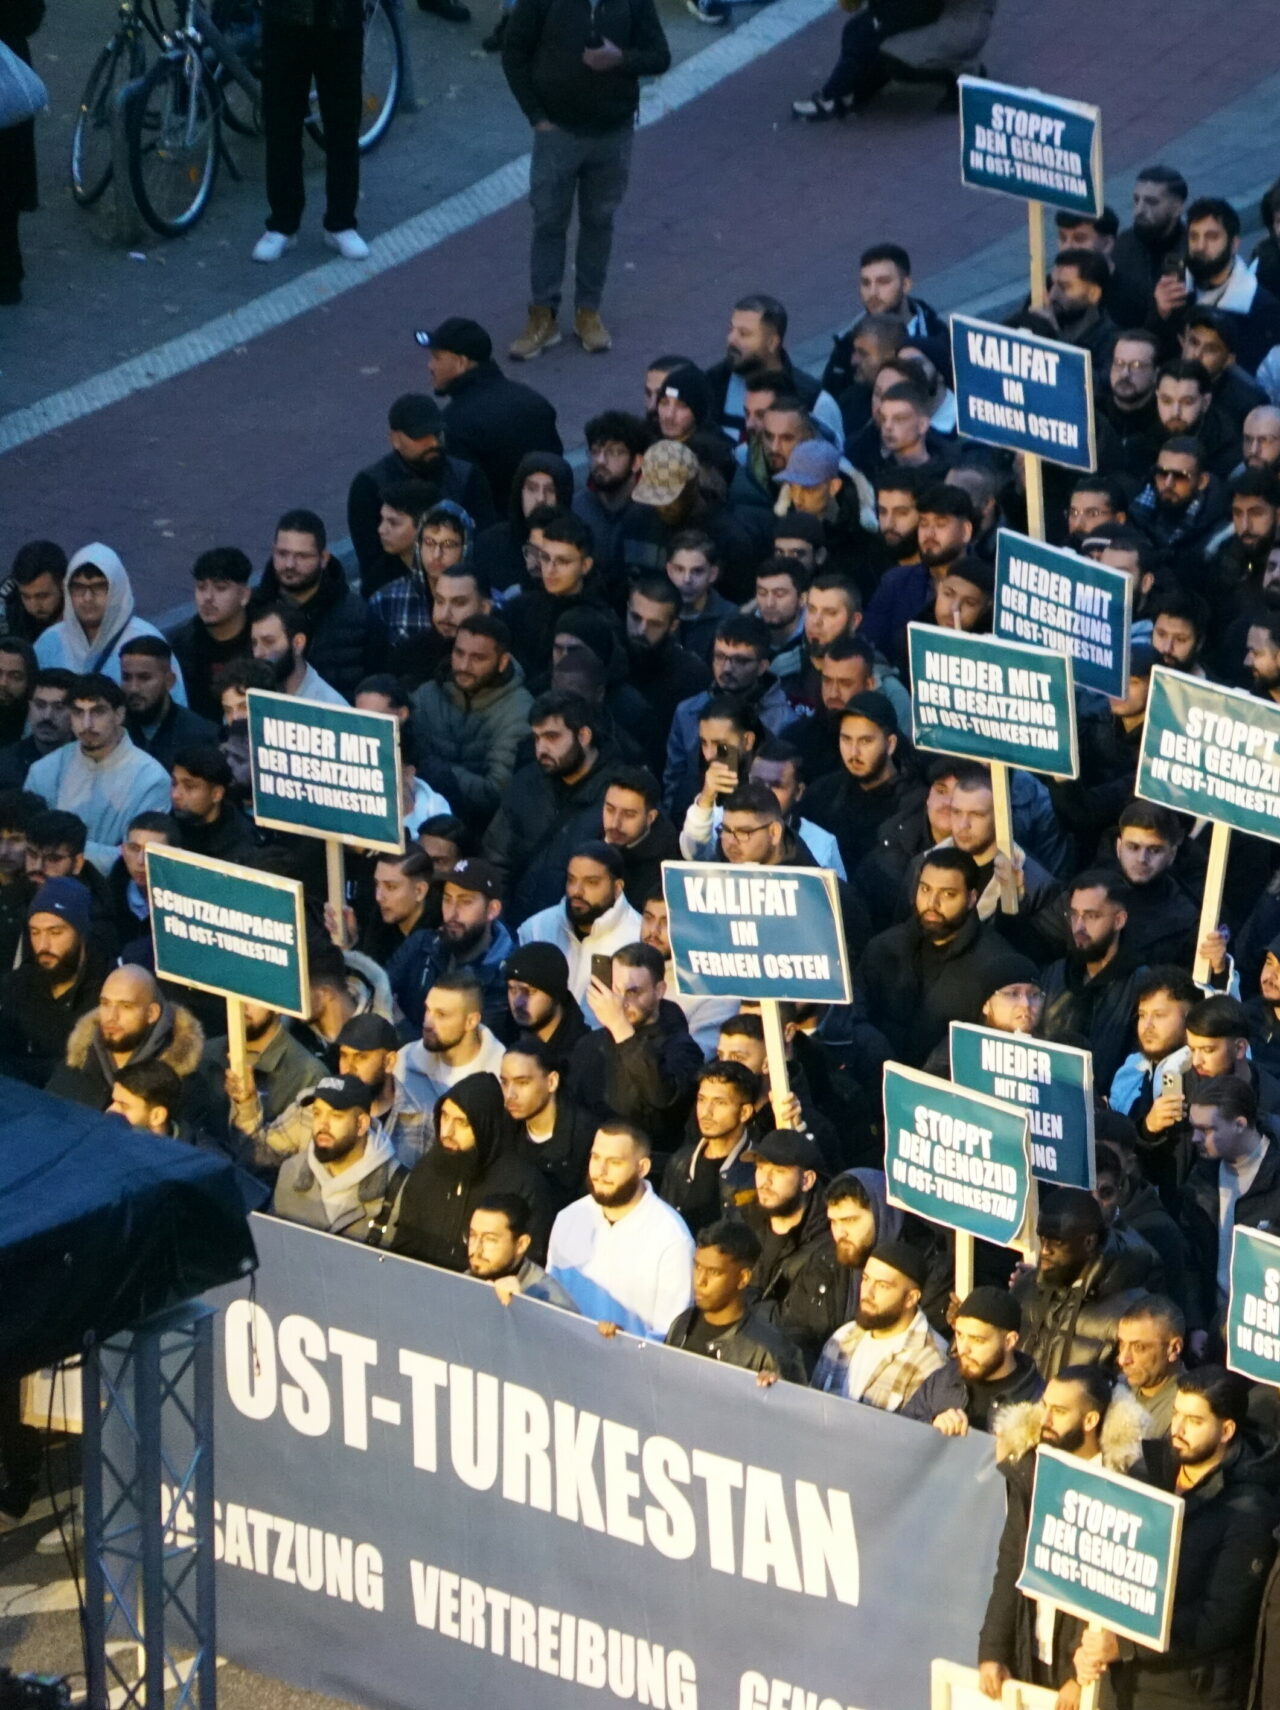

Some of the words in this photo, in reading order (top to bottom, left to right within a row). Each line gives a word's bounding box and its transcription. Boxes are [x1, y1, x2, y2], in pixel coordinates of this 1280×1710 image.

[992, 103, 1064, 146] STOPPT
[975, 126, 1006, 155] DEN
[1011, 136, 1080, 175] GENOZID
[968, 333, 1059, 385] KALIFAT
[1003, 379, 1024, 404] IM
[969, 397, 1025, 432] FERNEN
[1028, 413, 1078, 447] OSTEN
[1008, 557, 1071, 606] NIEDER
[1075, 581, 1111, 619] MIT
[1000, 610, 1013, 633] IN
[1001, 584, 1027, 617] DER
[1030, 595, 1110, 644] BESATZUNG
[925, 651, 1002, 693] NIEDER
[1008, 667, 1051, 704] MIT
[918, 679, 950, 707] DER
[953, 687, 1055, 727] BESATZUNG
[263, 717, 335, 758] NIEDER
[340, 732, 380, 766] MIT
[920, 705, 937, 725] IN
[940, 709, 1058, 750] OST-TURKESTAN
[1159, 730, 1202, 769] DEN
[1185, 706, 1278, 763] STOPPT
[257, 746, 287, 774] DER
[290, 753, 383, 793] BESATZUNG
[1150, 757, 1168, 782] IN
[260, 772, 274, 794] IN
[276, 776, 386, 817] OST-TURKESTAN
[153, 887, 293, 945] SCHUTZKAMPAGNE
[684, 876, 800, 915] KALIFAT
[189, 922, 288, 967] OST-TURKESTAN
[730, 921, 758, 946] IM
[688, 949, 760, 977] FERNEN
[762, 953, 830, 979] OSTEN
[981, 1038, 1052, 1085] NIEDER
[994, 1076, 1017, 1100] MIT
[1018, 1083, 1040, 1105] DER
[914, 1104, 991, 1162] STOPPT
[899, 1128, 930, 1167] DEN
[933, 1139, 1016, 1195] GENOZID
[908, 1164, 1016, 1222] OST-TURKESTAN
[1237, 1325, 1251, 1351] IN
[1243, 1295, 1280, 1335] DEN
[225, 1299, 860, 1607] OST-TURKESTAN
[1062, 1489, 1141, 1548] STOPPT
[1042, 1514, 1077, 1555] DEN
[1078, 1529, 1157, 1587] GENOZID
[1034, 1544, 1049, 1571] IN
[1051, 1552, 1155, 1614] OST-TURKESTAN
[410, 1559, 698, 1710] VERTREIBUNG
